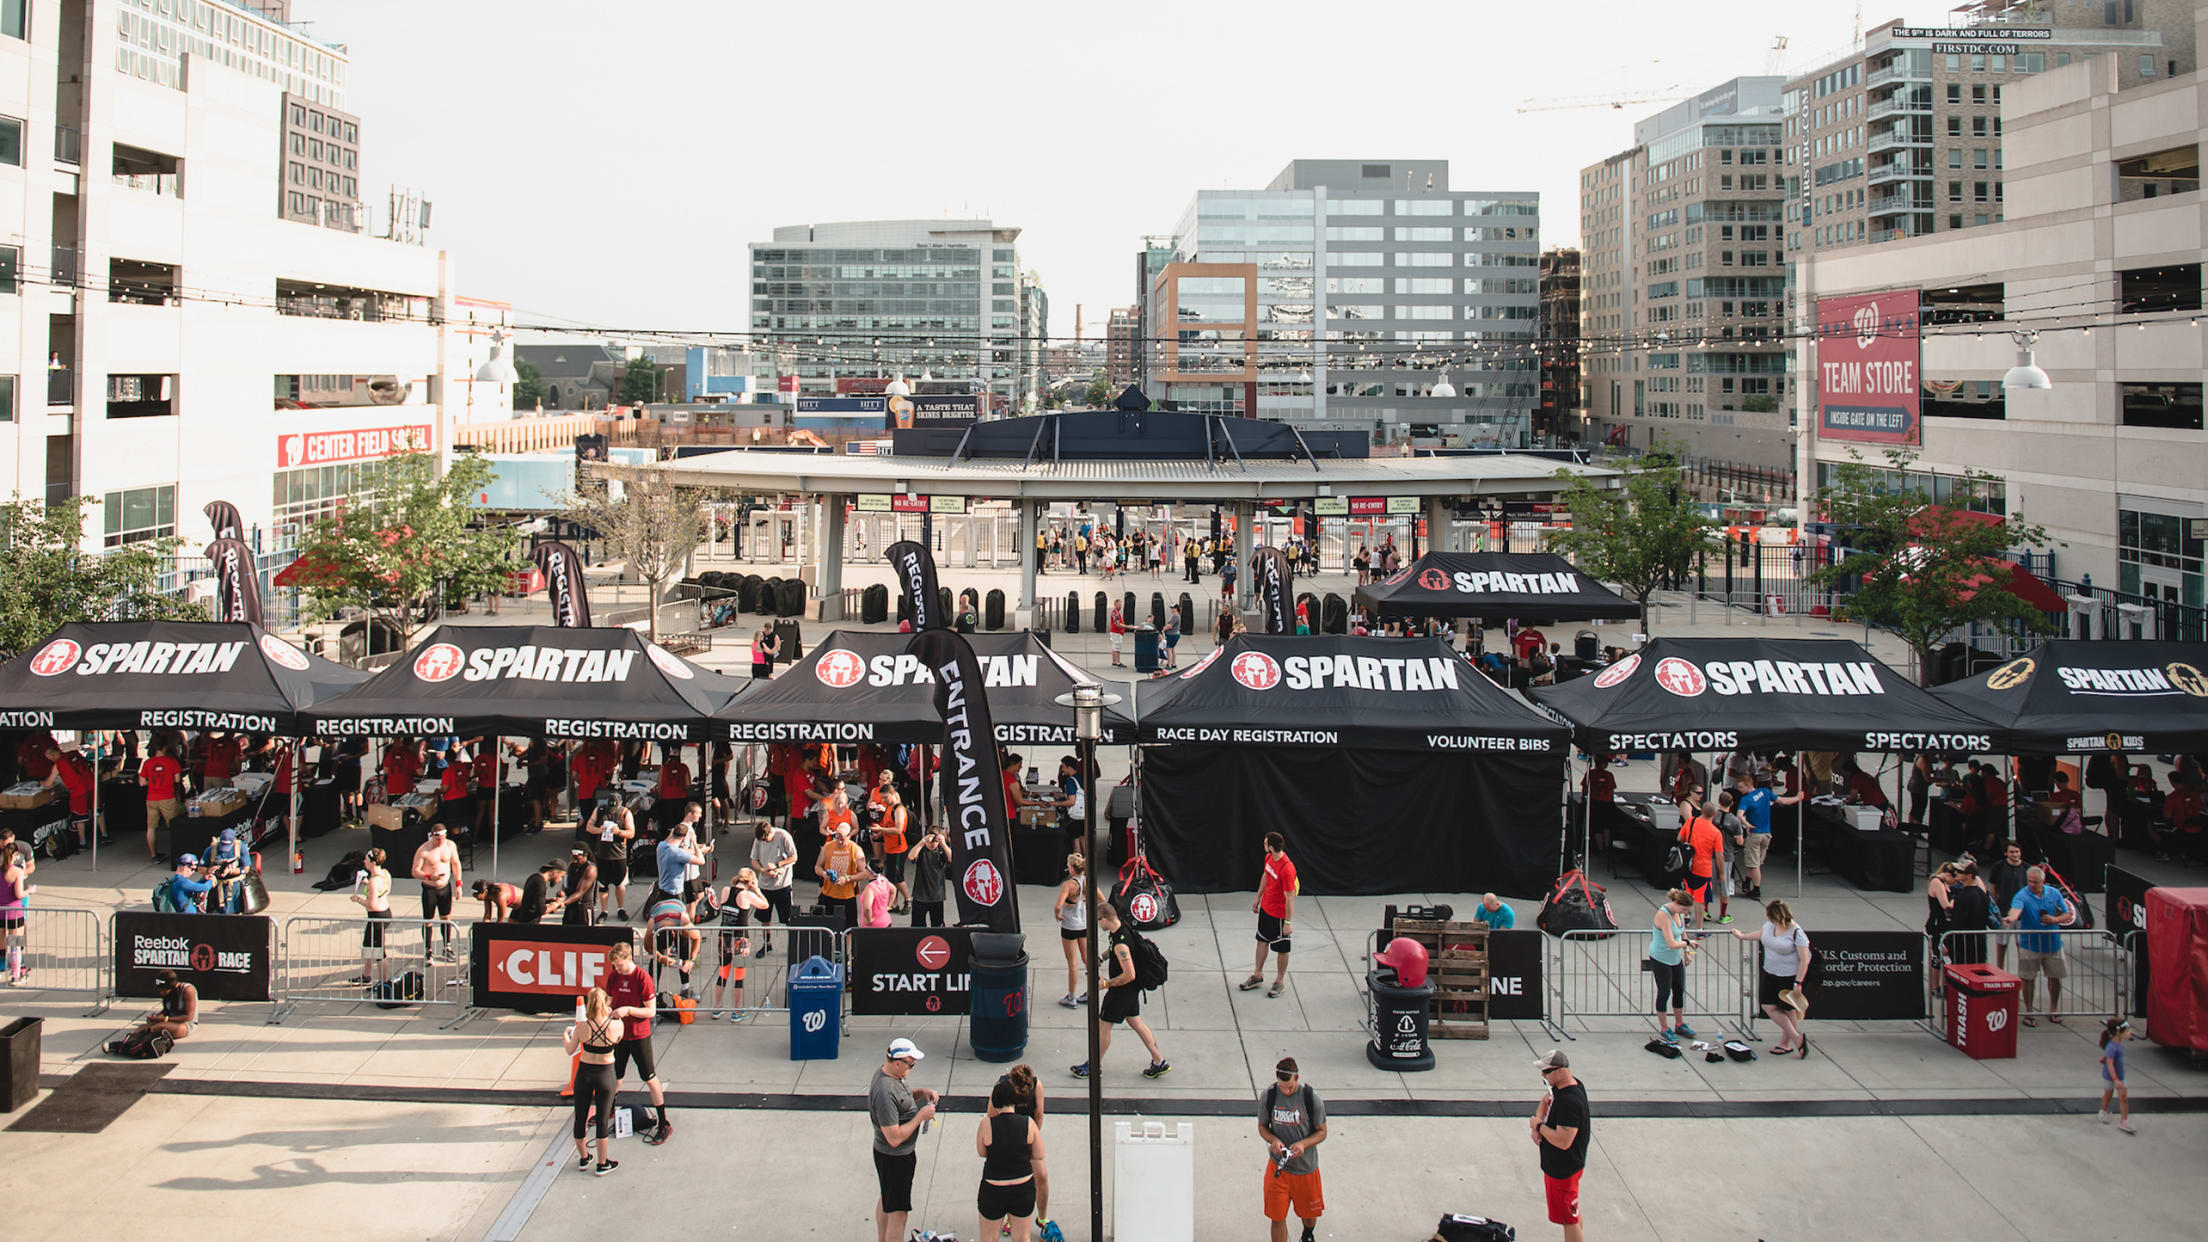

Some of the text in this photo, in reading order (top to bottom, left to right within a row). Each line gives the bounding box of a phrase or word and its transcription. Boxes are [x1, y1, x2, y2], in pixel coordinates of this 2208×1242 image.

[1894, 29, 1909, 37] THE
[1925, 29, 1933, 37] IS
[1935, 29, 1958, 38] DARK
[1959, 30, 1977, 38] AND
[1978, 30, 1998, 38] FULL
[2000, 30, 2009, 38] OF
[2012, 30, 2050, 39] TERRORS
[1936, 43, 2016, 54] FIRSTDC.COM
[1801, 88, 1811, 208] FIRSTDC.COM
[1823, 360, 1914, 394] TEAM STORE
[1830, 411, 1904, 428] INSIDE GATE ON THE LEFT
[307, 433, 355, 462] CENTER
[357, 430, 389, 457] FIELD
[1453, 570, 1580, 594] SPARTAN
[76, 640, 245, 676] SPARTAN
[463, 645, 633, 682] SPARTAN
[868, 654, 1039, 688] SPATAN
[1284, 654, 1459, 691] SPARTAN
[1705, 659, 1885, 696] SPARTAN
[2056, 666, 2172, 691] SPARTAN
[140, 710, 276, 732] REGISTRATION
[315, 717, 454, 736] REGISTRATION
[545, 719, 689, 740] REGISTRATION
[729, 722, 874, 741] REGISTRATION
[1156, 727, 1338, 745] RACE DAY REGISTRATION
[1608, 731, 1738, 751] SPECTATORS
[1427, 734, 1550, 752] VOLUNTEER BIBS
[1865, 732, 1992, 752] SPECTATORS
[2066, 735, 2144, 749] SPARTAN KIDS
[939, 659, 991, 851] ENTRANCE
[134, 934, 190, 950] Reebok
[133, 949, 251, 969] SPARTAN RACE
[1839, 950, 1886, 961] Customs
[1887, 950, 1907, 961] and
[506, 948, 606, 989] CLIF
[1825, 961, 1912, 973] order Protection
[871, 973, 940, 992] START
[1821, 979, 1881, 988] bp.gov/careers
[1957, 991, 1967, 1047] TRASH
